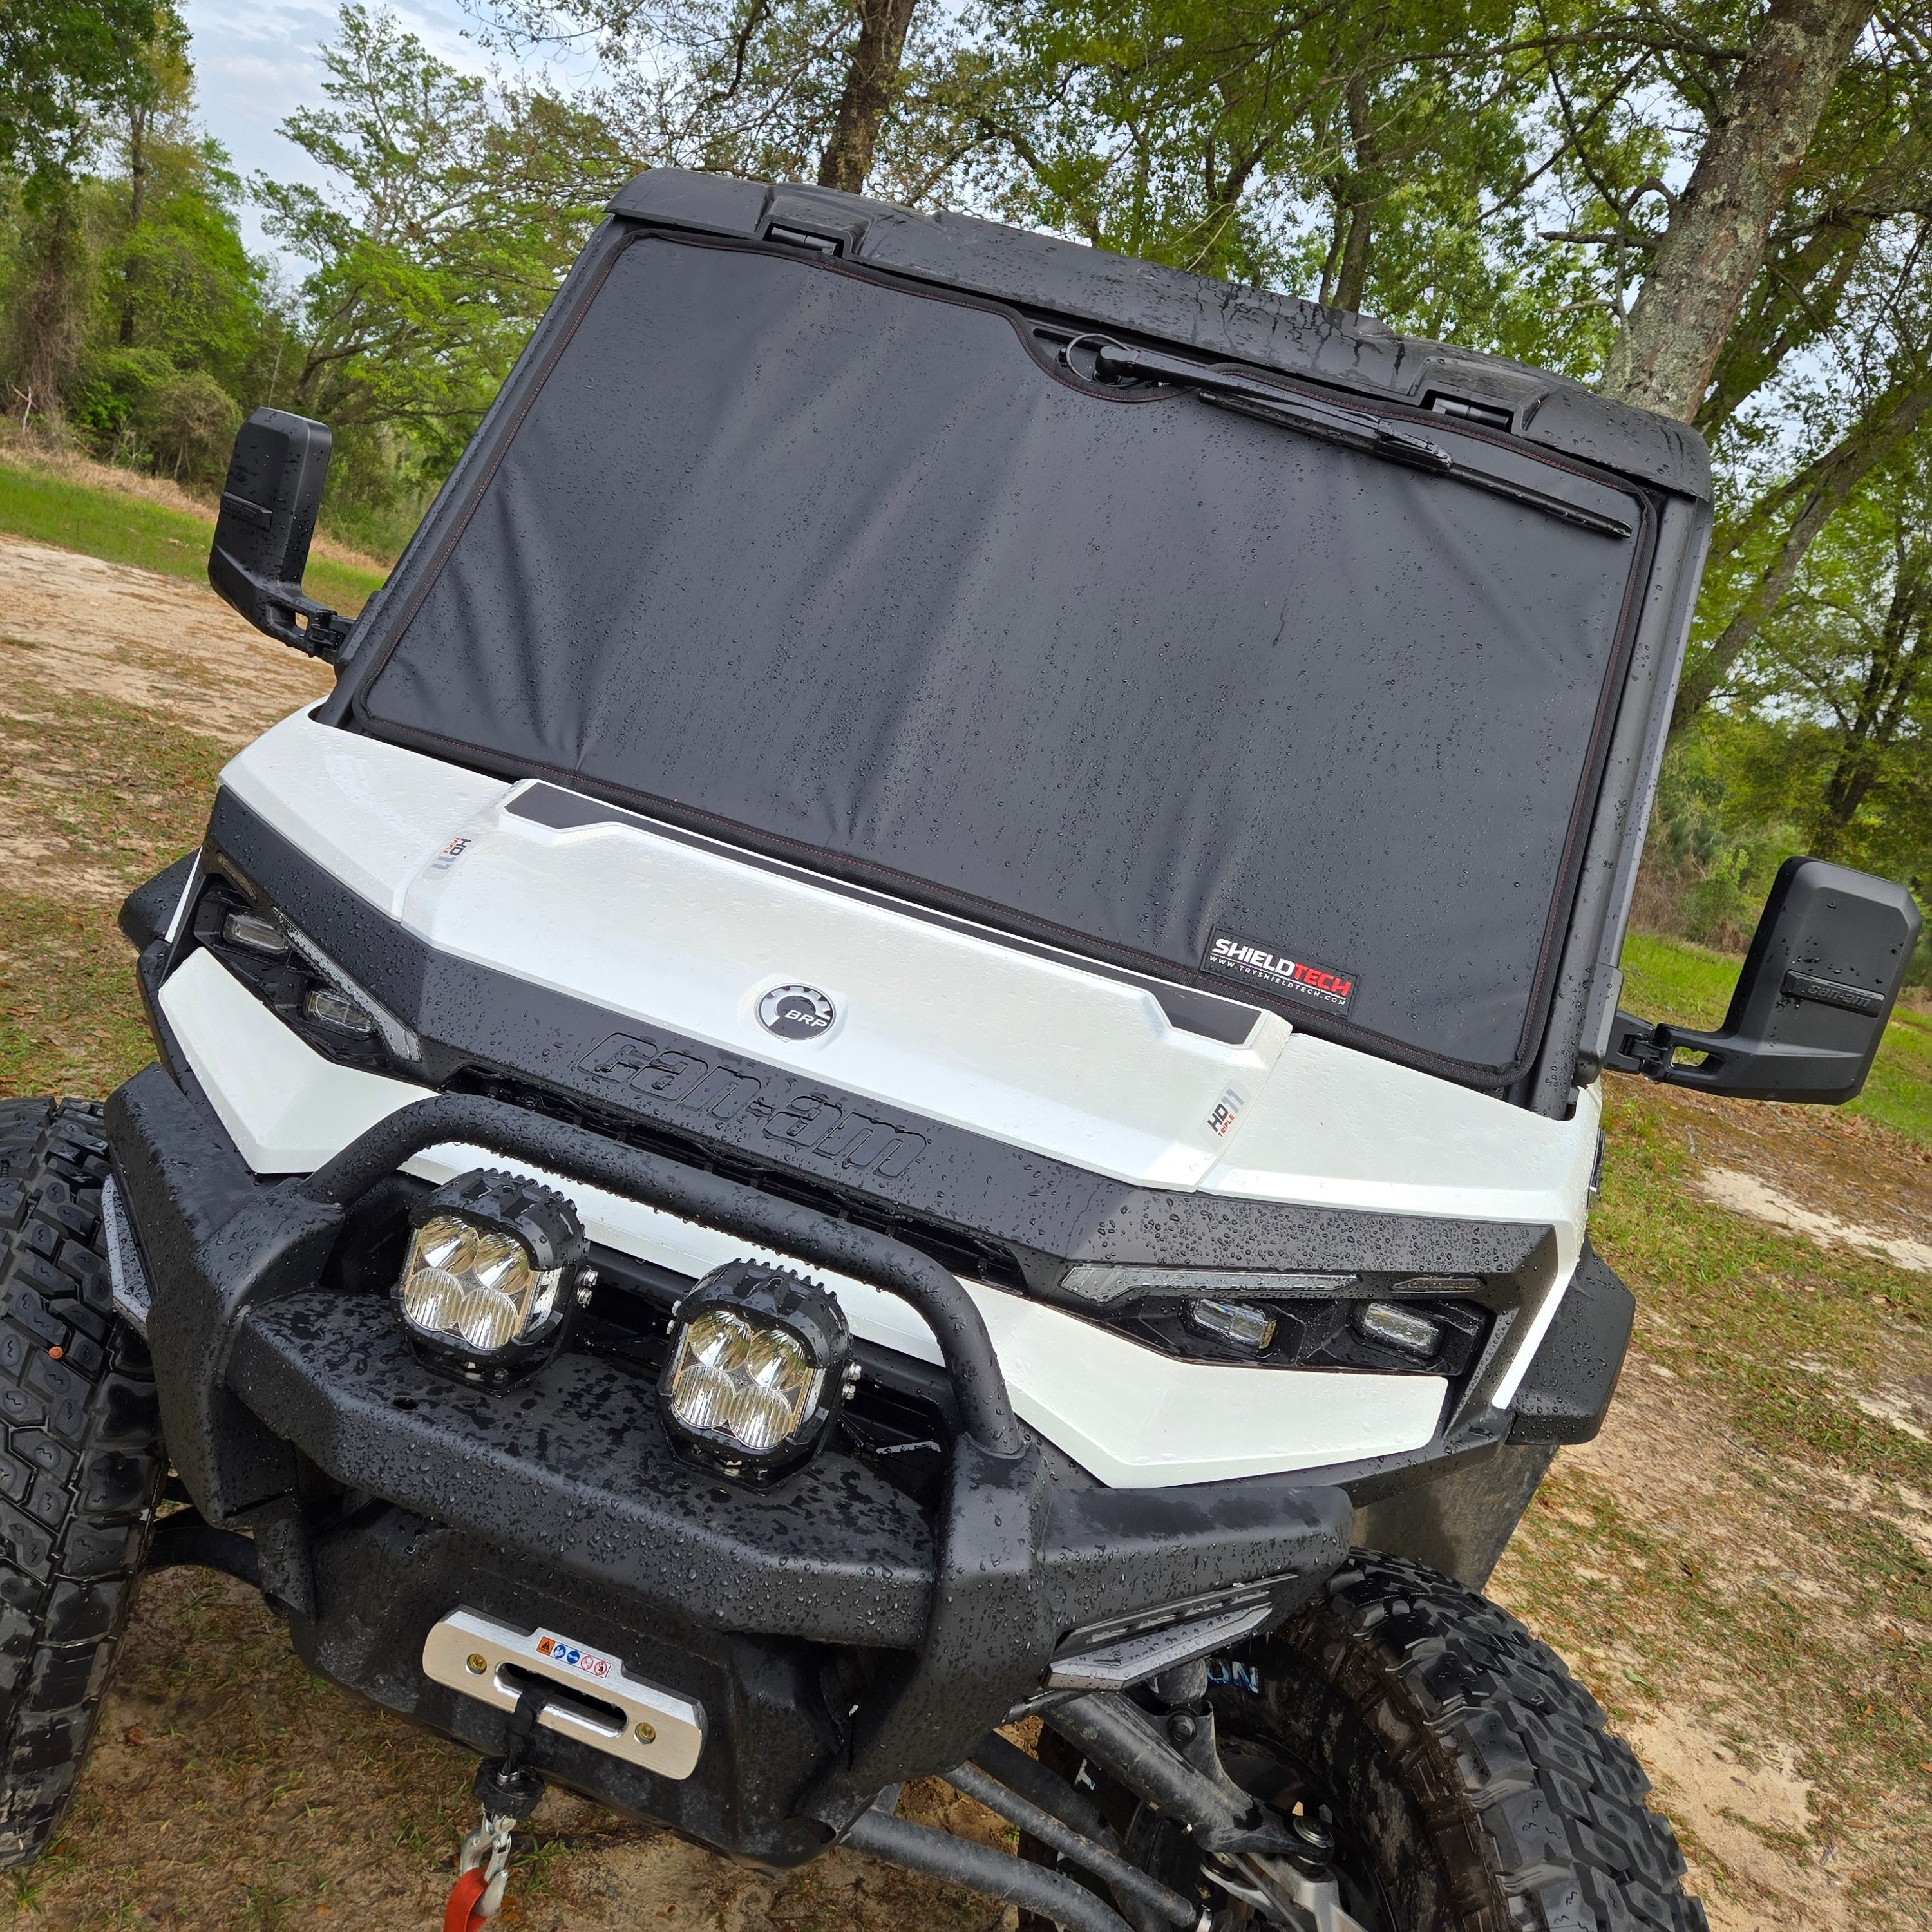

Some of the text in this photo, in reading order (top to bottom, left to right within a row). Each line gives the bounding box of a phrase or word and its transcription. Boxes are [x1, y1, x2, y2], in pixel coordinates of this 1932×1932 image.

[442, 837, 461, 855] TRIPLE
[1211, 938, 1352, 997] SHIELDTECH
[1807, 985, 1871, 1008] can-am
[784, 1009, 828, 1027] BRP
[1207, 1088, 1244, 1133] HD11
[1217, 1113, 1235, 1138] TRIPLE
